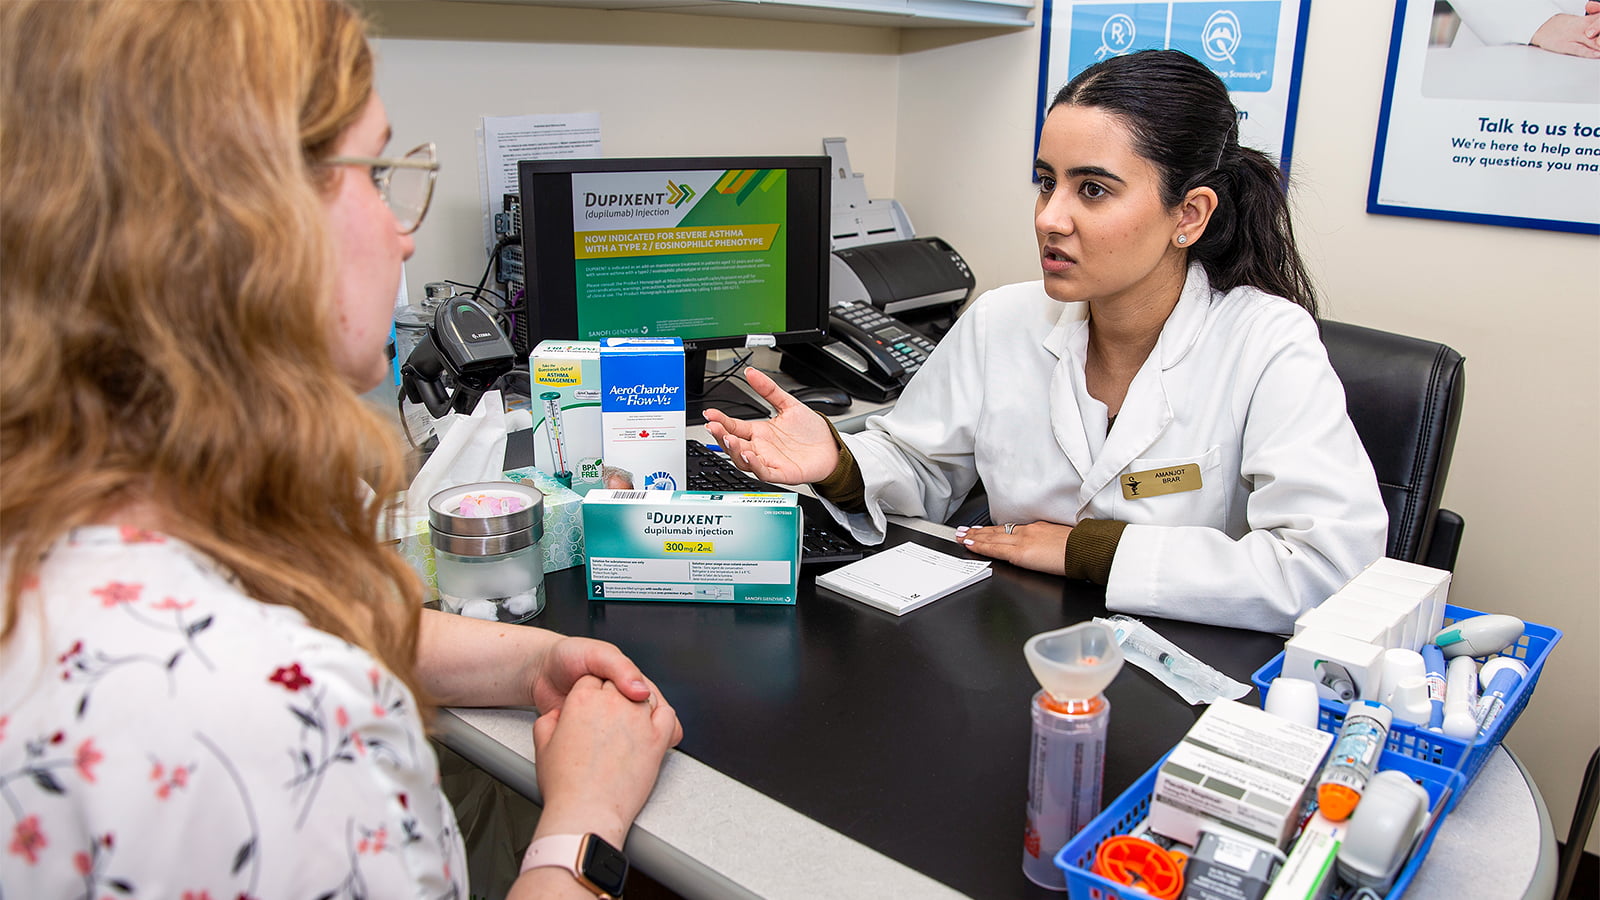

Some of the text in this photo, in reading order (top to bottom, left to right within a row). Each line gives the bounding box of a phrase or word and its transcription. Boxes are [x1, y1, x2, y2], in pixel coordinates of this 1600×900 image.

[1478, 117, 1514, 134] Talk
[1521, 120, 1540, 134] to
[1546, 124, 1567, 136] us
[1452, 138, 1486, 150] We're
[1490, 140, 1518, 151] here
[1524, 142, 1536, 152] to
[1541, 143, 1570, 156] help
[1452, 156, 1600, 174] any questions you ma
[585, 192, 665, 207] DUPIXENT
[585, 208, 634, 220] (dupilumab)
[585, 230, 743, 243] NOW INDICATED FOR SEVERE ASTHMA
[585, 244, 608, 253] WITH
[610, 244, 617, 252] A
[619, 243, 640, 251] TYPE
[648, 242, 653, 251] /
[655, 240, 714, 250] EOSINOPHILIC
[716, 238, 764, 246] PHENOTYPE
[609, 384, 680, 395] AeroChamber
[627, 394, 672, 406] Flow-Vu
[1155, 469, 1185, 478] AMANJOT
[654, 512, 724, 525] DUPIXENT
[644, 526, 734, 538] dupilumab injection
[594, 585, 602, 594] 2
